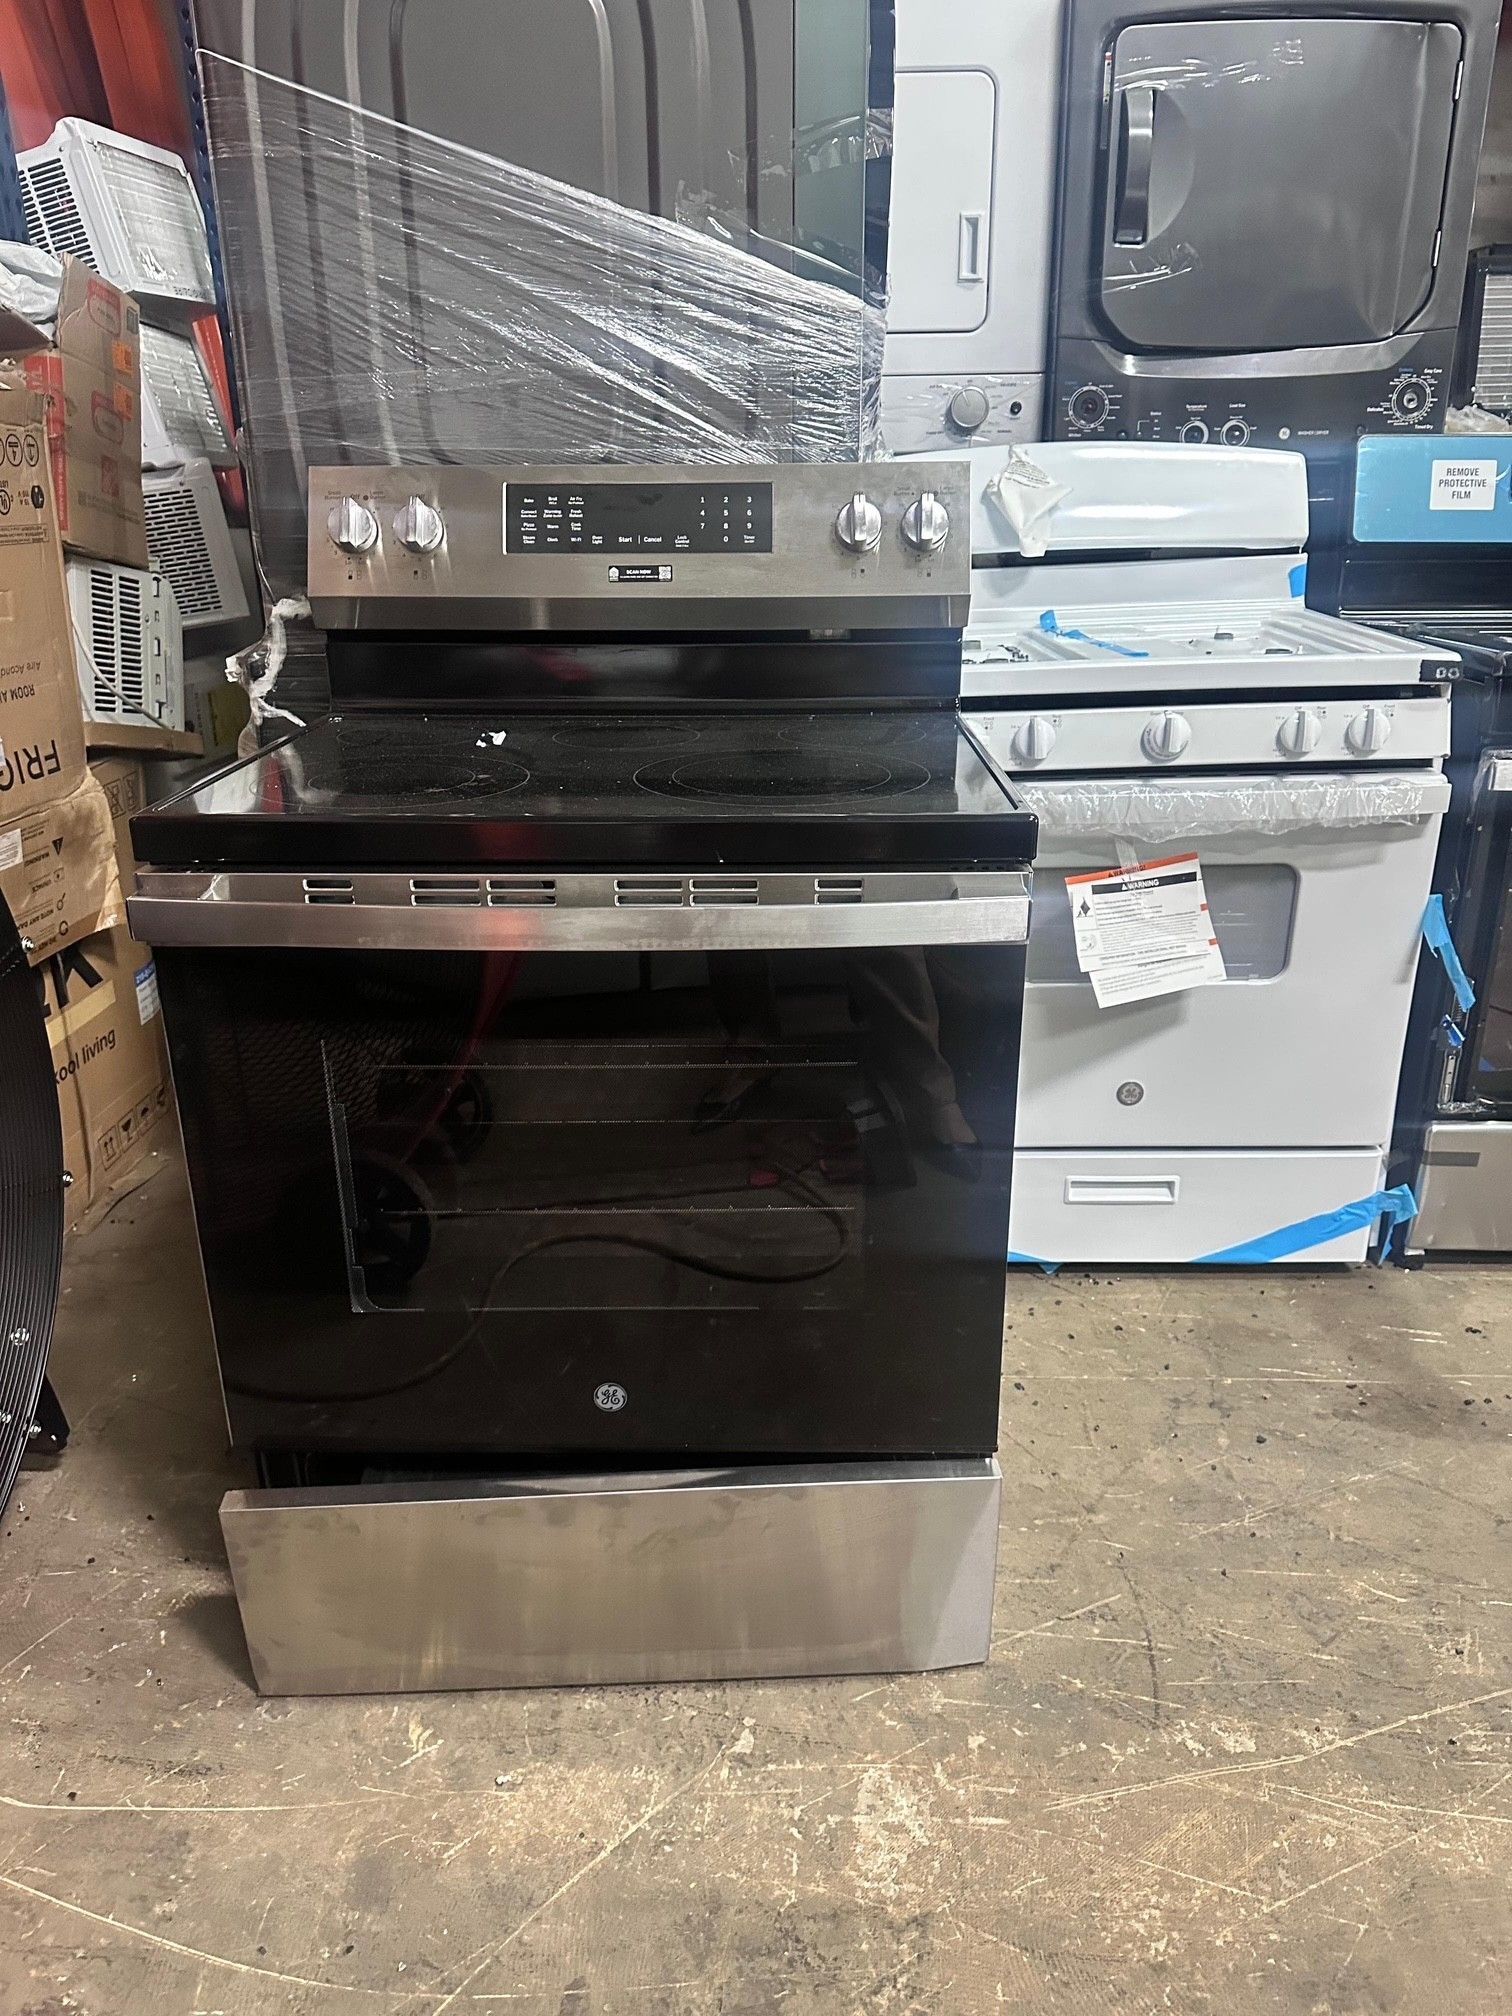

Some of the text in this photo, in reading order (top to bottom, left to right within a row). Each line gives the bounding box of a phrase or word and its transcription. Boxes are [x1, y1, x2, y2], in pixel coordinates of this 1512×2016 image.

[1446, 467, 1480, 476] REMOVE
[1438, 478, 1487, 487] PROTECTIVE
[1451, 490, 1471, 499] FILM
[26, 660, 41, 672] Aire
[10, 684, 36, 701] ROOM
[1128, 879, 1160, 891] WARNING
[82, 1029, 116, 1064] living
